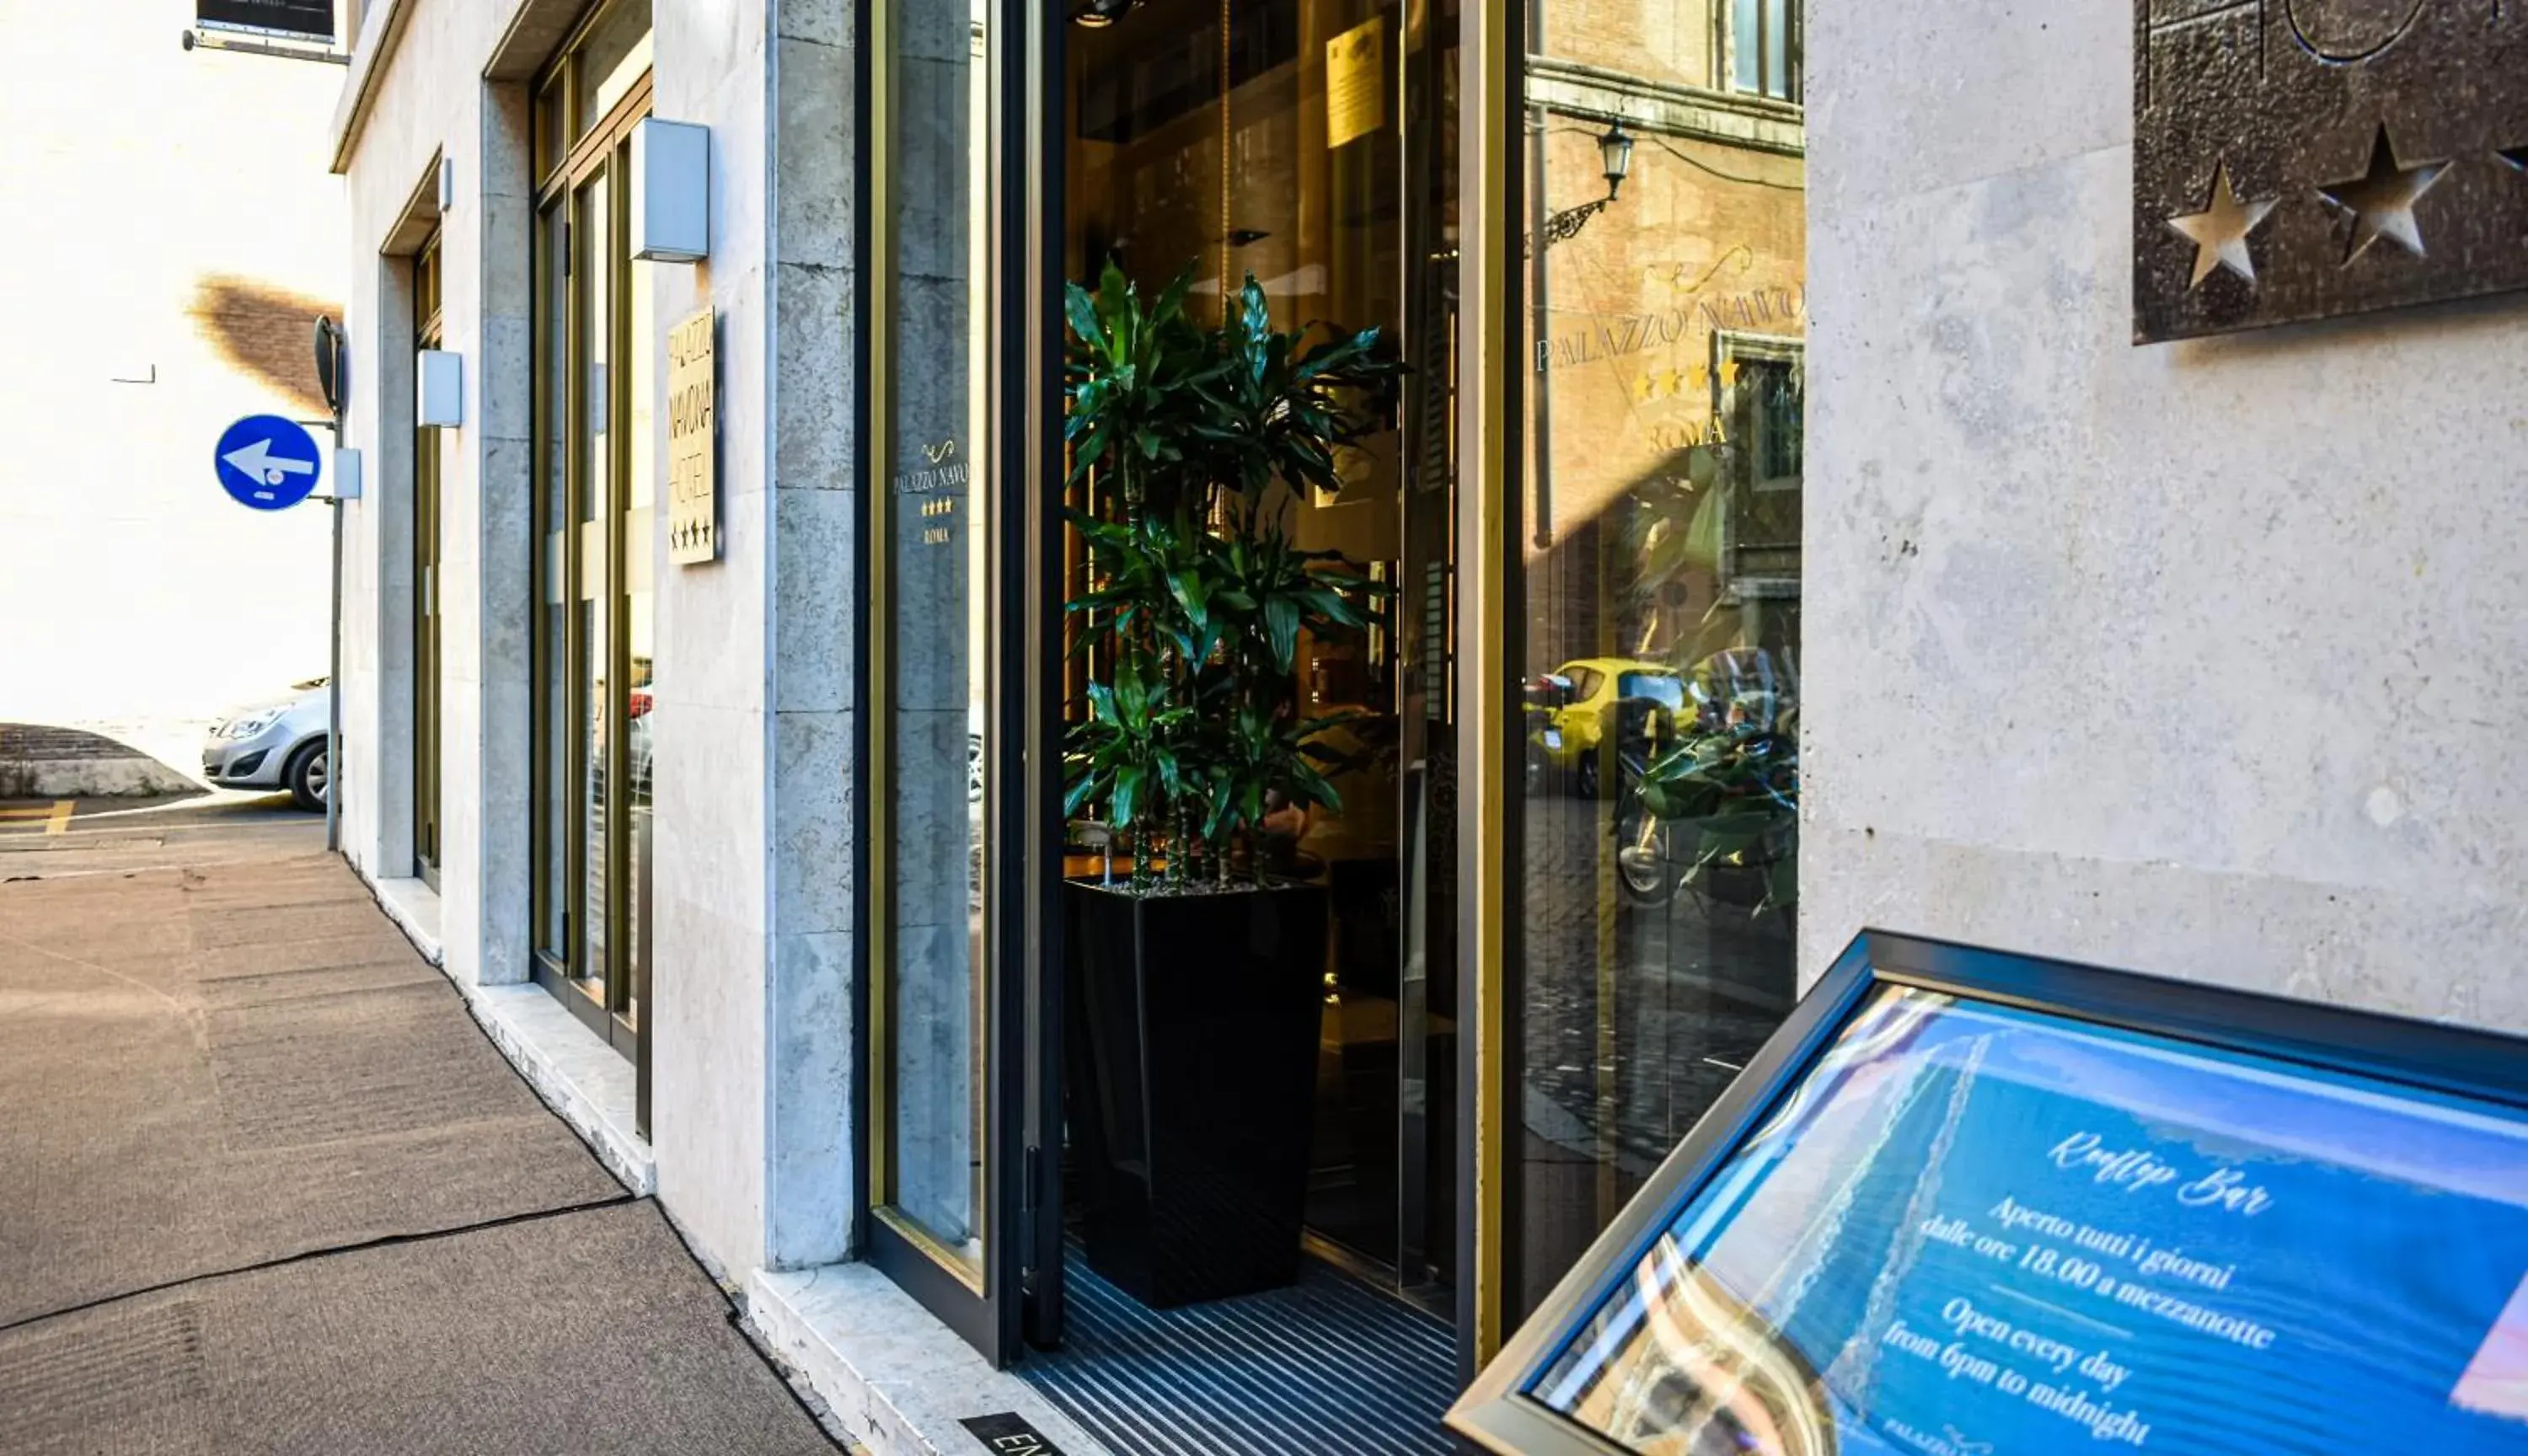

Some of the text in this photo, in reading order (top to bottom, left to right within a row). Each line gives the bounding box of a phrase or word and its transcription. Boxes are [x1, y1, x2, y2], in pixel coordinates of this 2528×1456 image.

[1535, 308, 1685, 372] PALAZZO
[1647, 410, 1728, 455] ROMA
[2048, 1131, 2274, 1216] Rooftop Bar
[1920, 1213, 2277, 1350] dalle ore 18.00 a mezzanotte
[1987, 1194, 2237, 1291] Aperto tutti i giorni
[1882, 1318, 2152, 1447] from 6pm to midnight
[1942, 1296, 2134, 1394] Open every day
